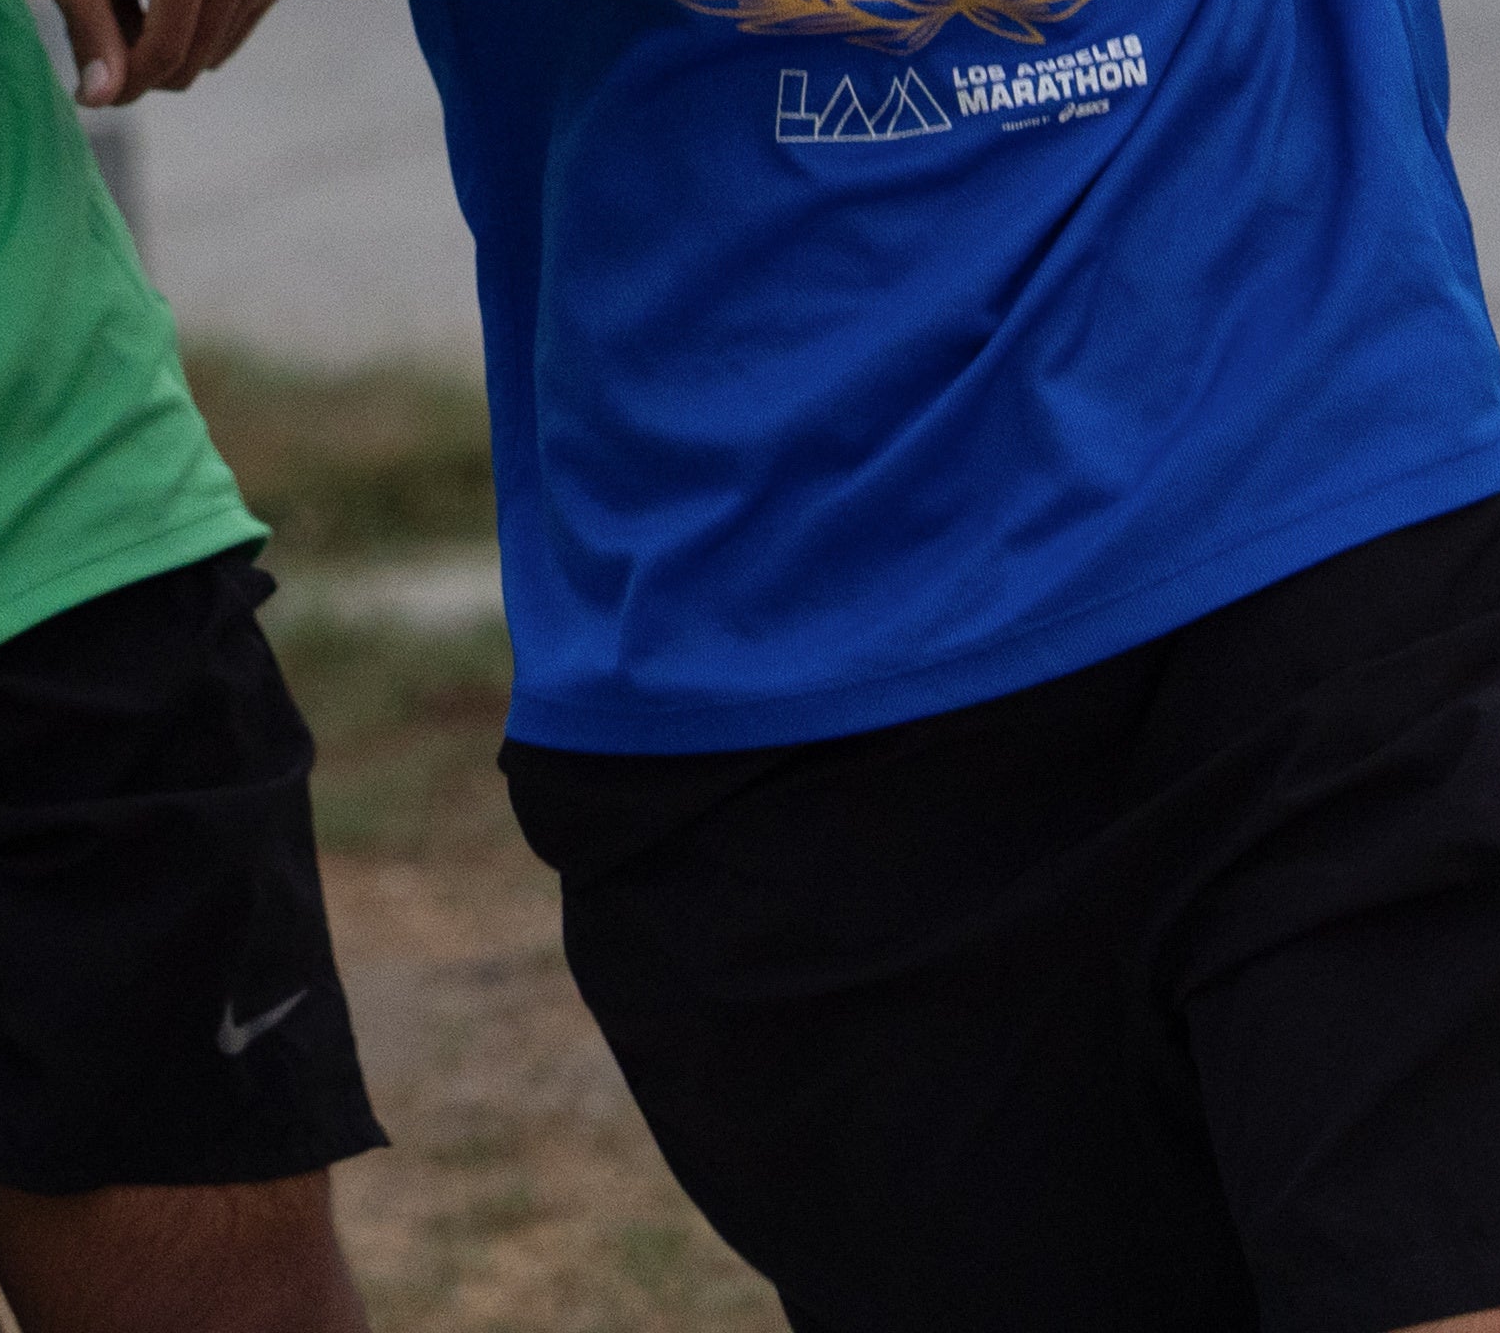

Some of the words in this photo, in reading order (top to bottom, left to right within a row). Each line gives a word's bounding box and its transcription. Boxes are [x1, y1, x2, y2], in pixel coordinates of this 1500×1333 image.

[952, 64, 1006, 89] LOS
[1017, 33, 1145, 78] ANGELES
[956, 57, 1149, 118] MARATHON
